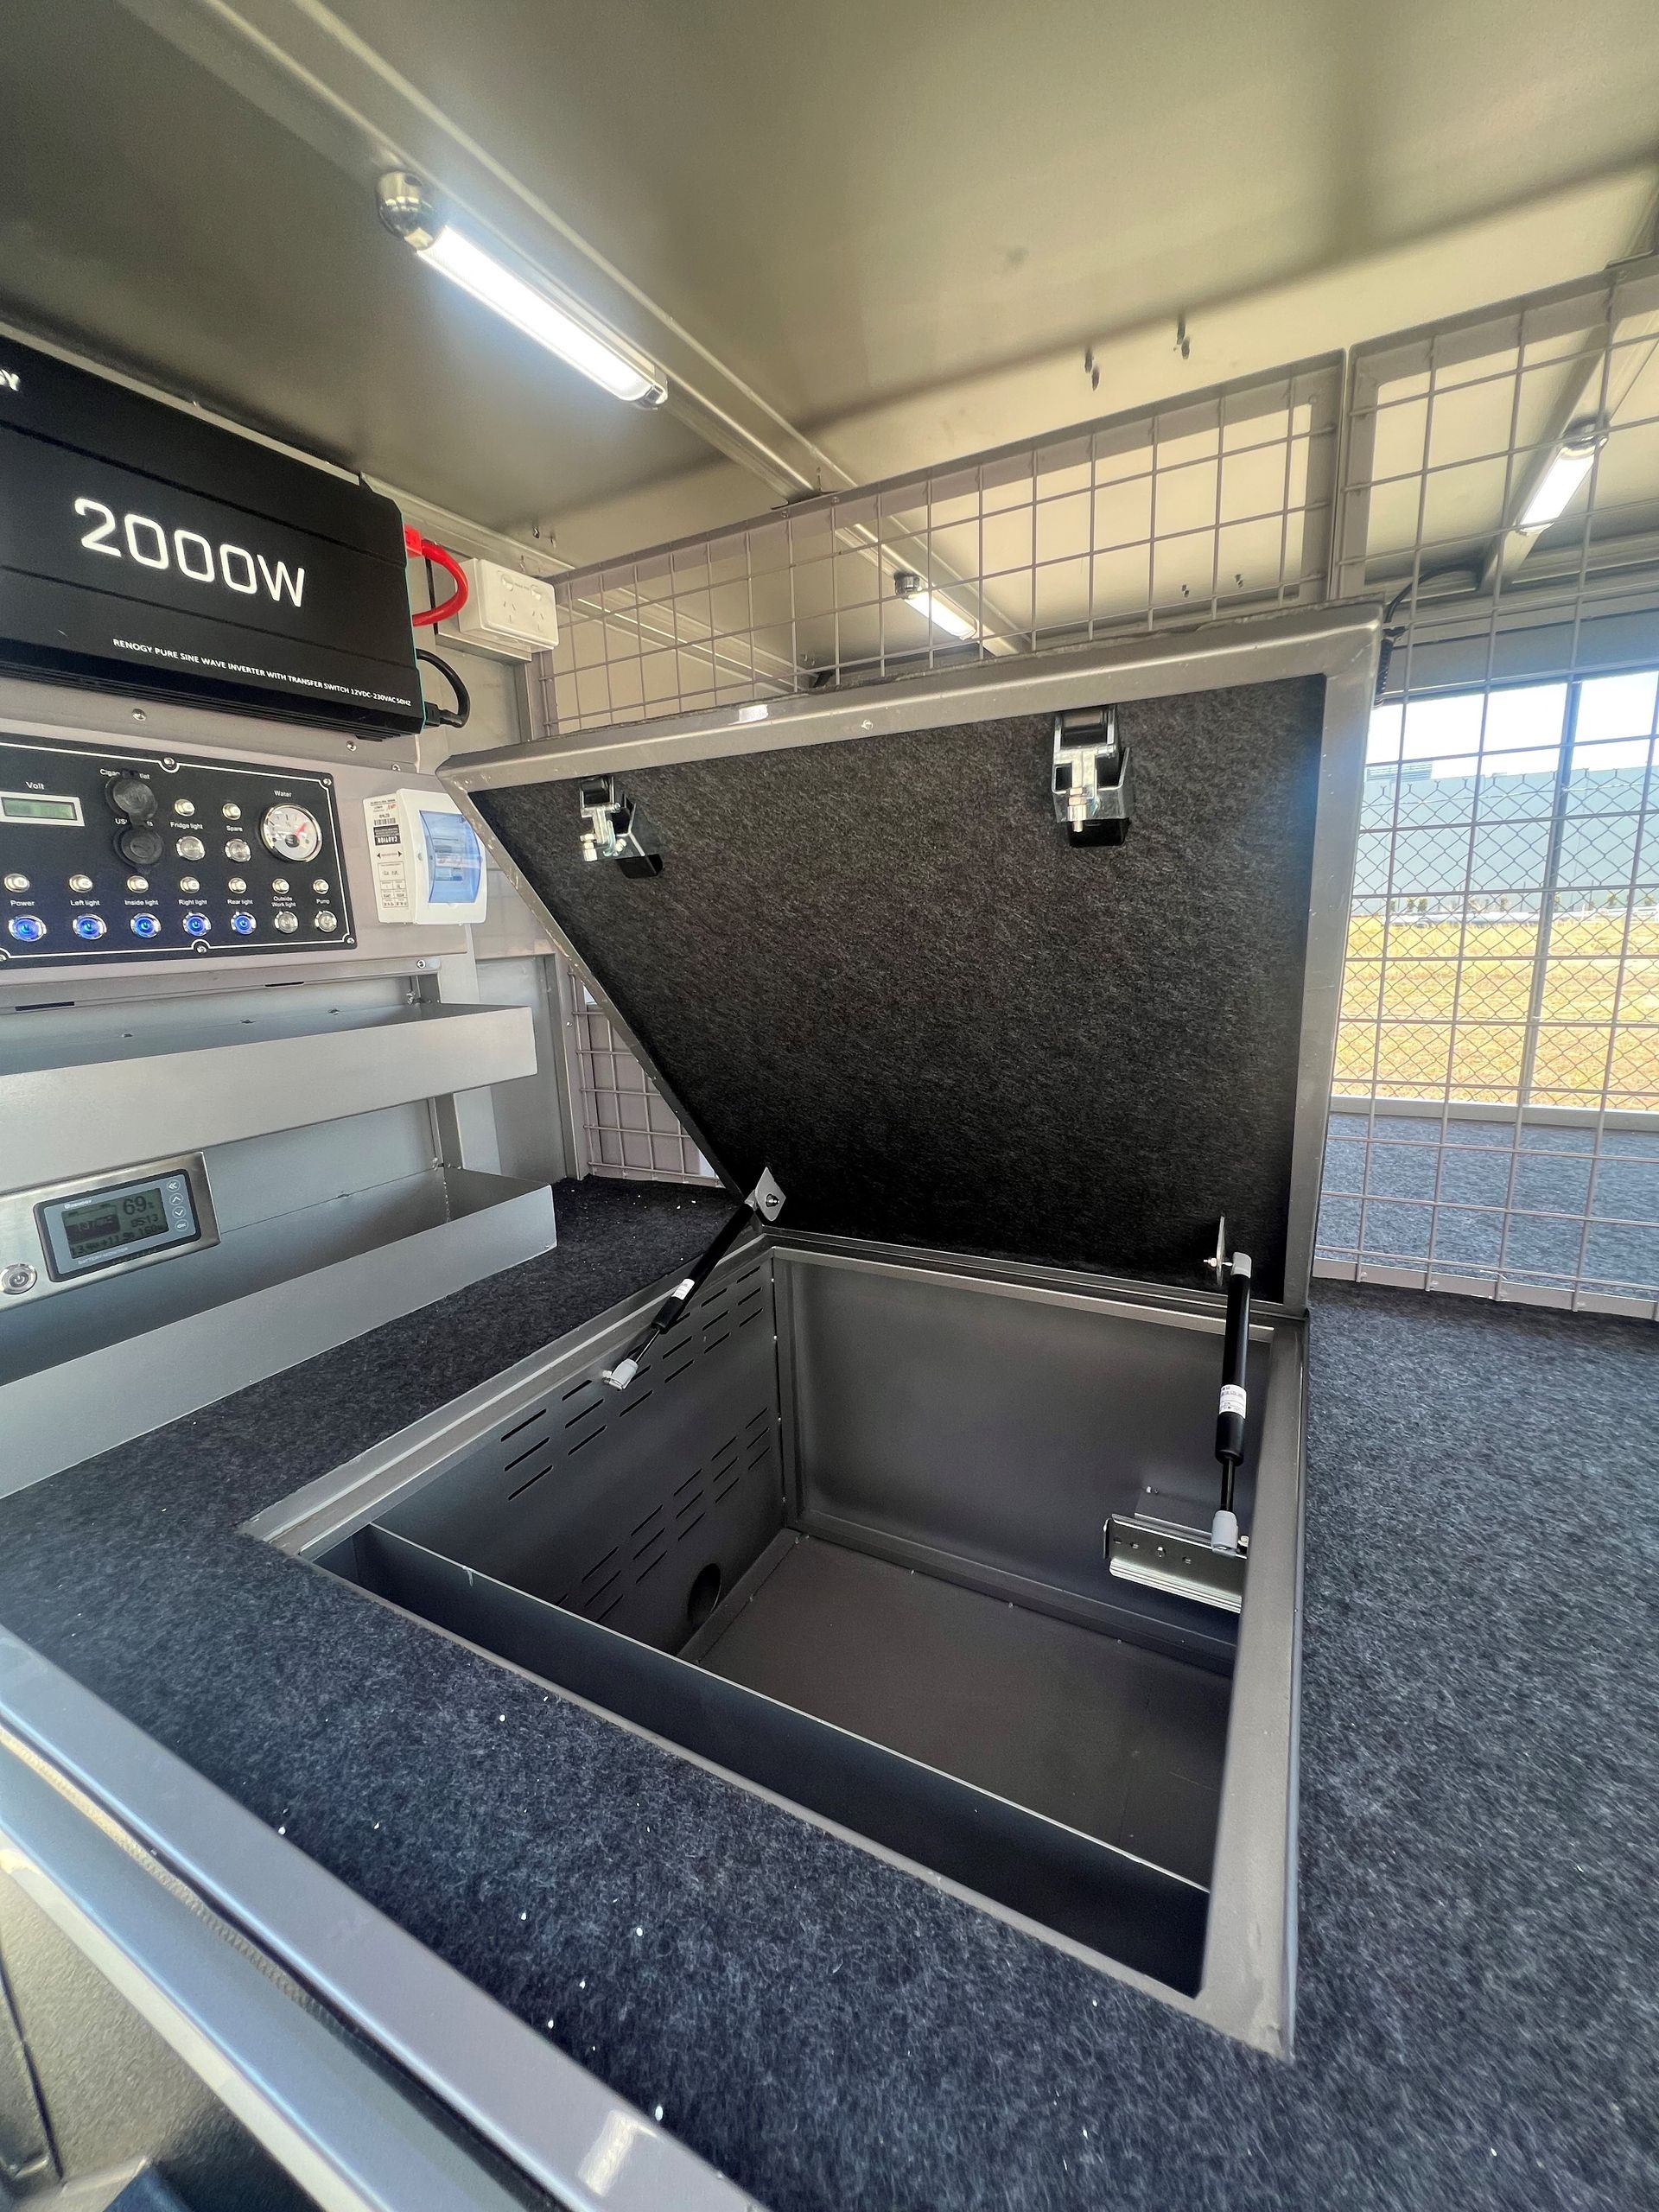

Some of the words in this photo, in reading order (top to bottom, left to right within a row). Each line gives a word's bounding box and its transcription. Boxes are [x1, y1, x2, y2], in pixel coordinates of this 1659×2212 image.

[74, 498, 305, 607] 2000W
[112, 638, 152, 654] RENOGY
[154, 647, 179, 659] PURE
[180, 652, 200, 664] SINE
[200, 657, 226, 669] WAVE
[227, 663, 265, 677] INVERTER
[266, 671, 287, 681] WITH
[288, 675, 323, 689] TRANSFER
[323, 683, 349, 694] SWITCH
[350, 688, 397, 703] 12VDC-230VAC
[25, 781, 45, 790] Volt
[170, 821, 189, 830] Fridge
